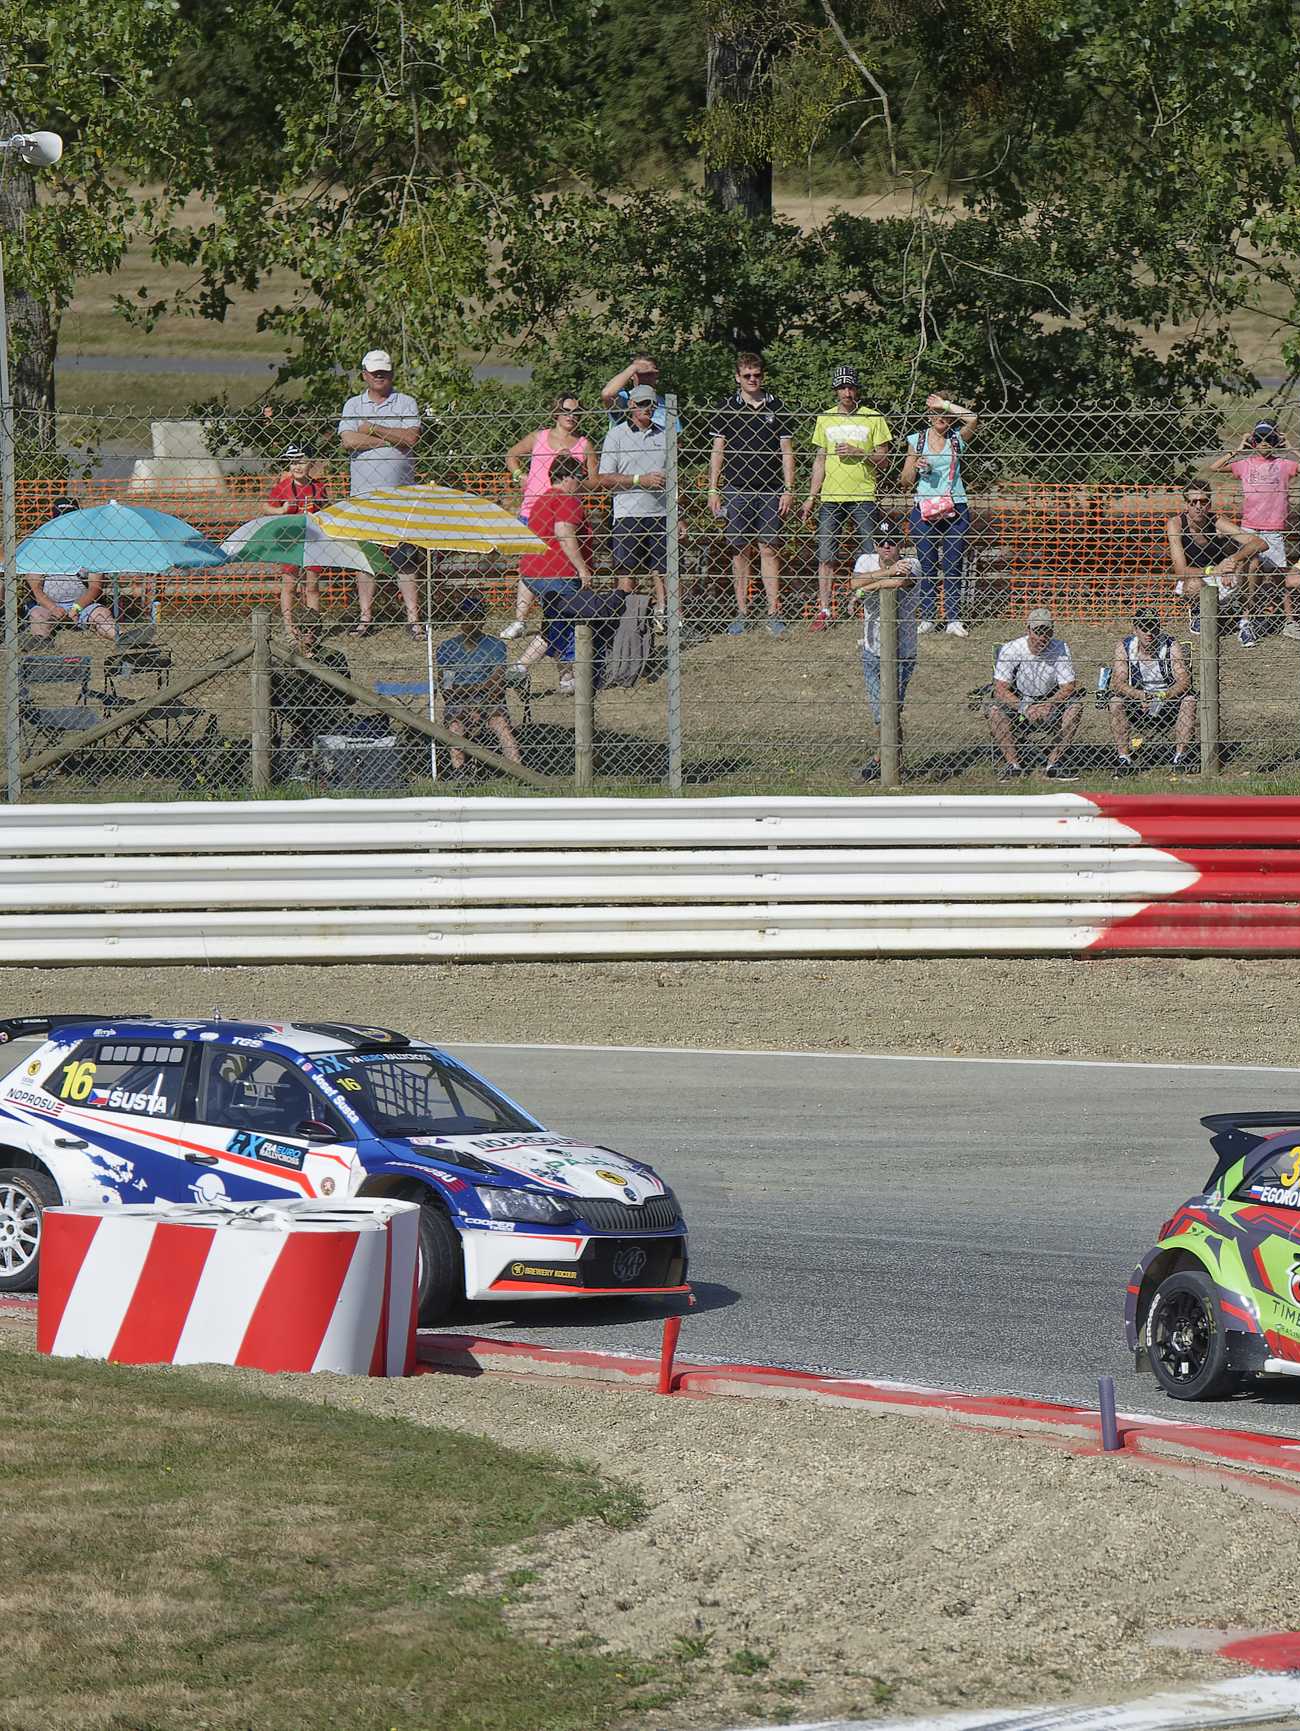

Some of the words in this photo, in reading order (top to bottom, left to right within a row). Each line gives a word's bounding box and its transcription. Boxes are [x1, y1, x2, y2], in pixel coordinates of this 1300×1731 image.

[60, 1060, 97, 1101] 16
[336, 1077, 362, 1092] 16
[5, 1088, 57, 1112] NOPROSU
[109, 1087, 167, 1115] ŠUSTA
[464, 1217, 516, 1229] COOPER
